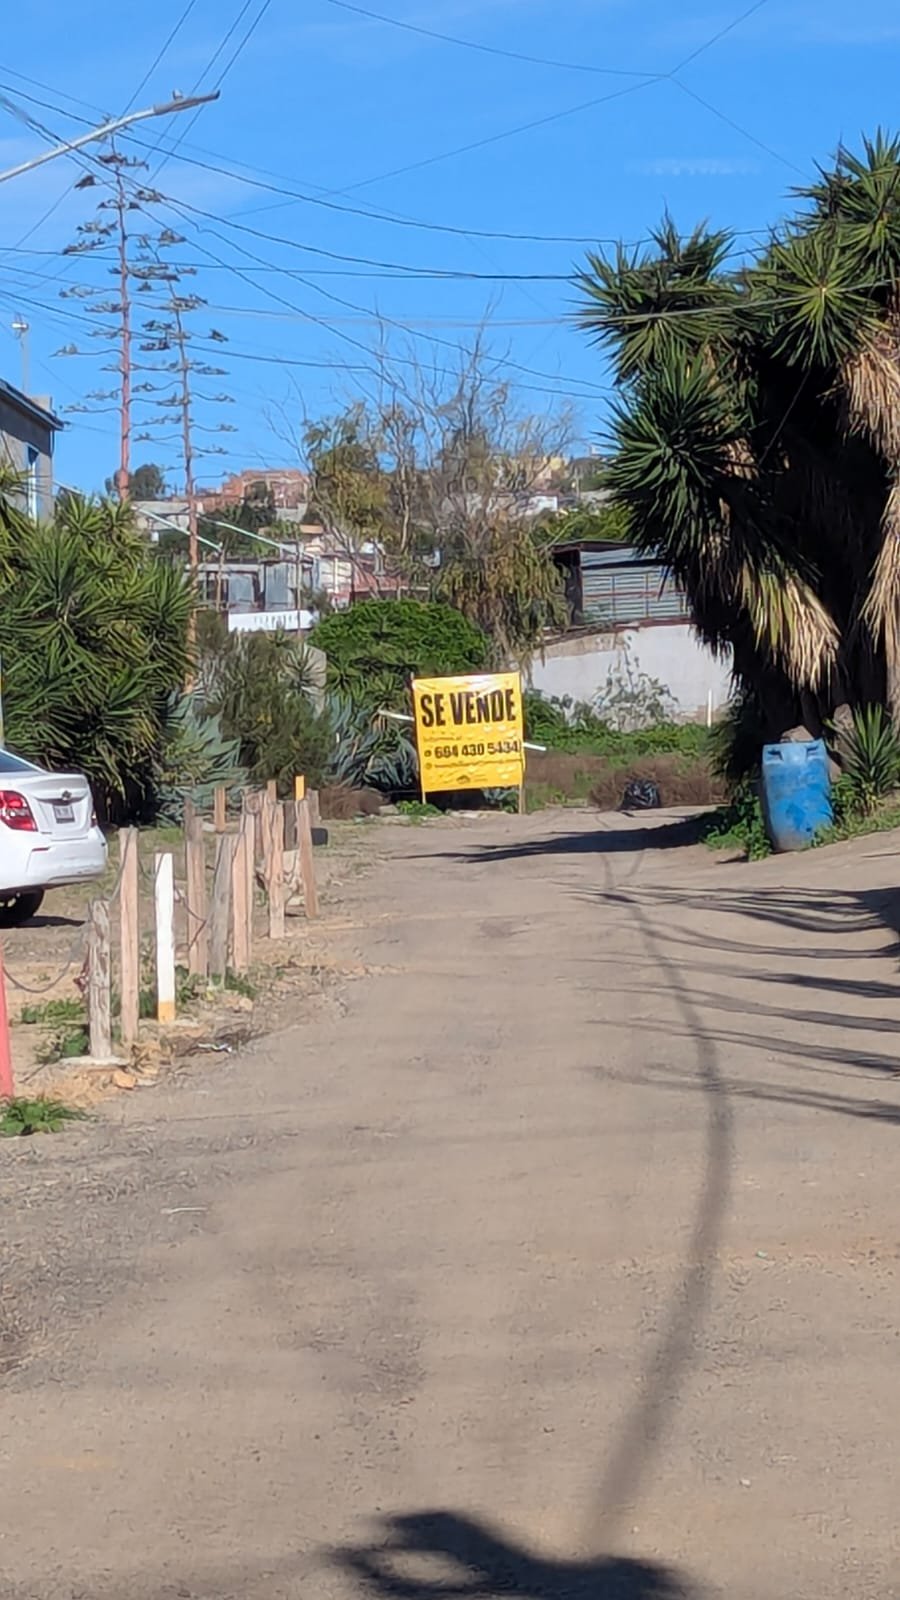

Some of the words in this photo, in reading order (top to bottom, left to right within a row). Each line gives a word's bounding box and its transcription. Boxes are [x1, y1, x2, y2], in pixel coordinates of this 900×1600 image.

[420, 693, 446, 727] SE
[449, 688, 516, 725] VENDE
[461, 743, 485, 757] 430
